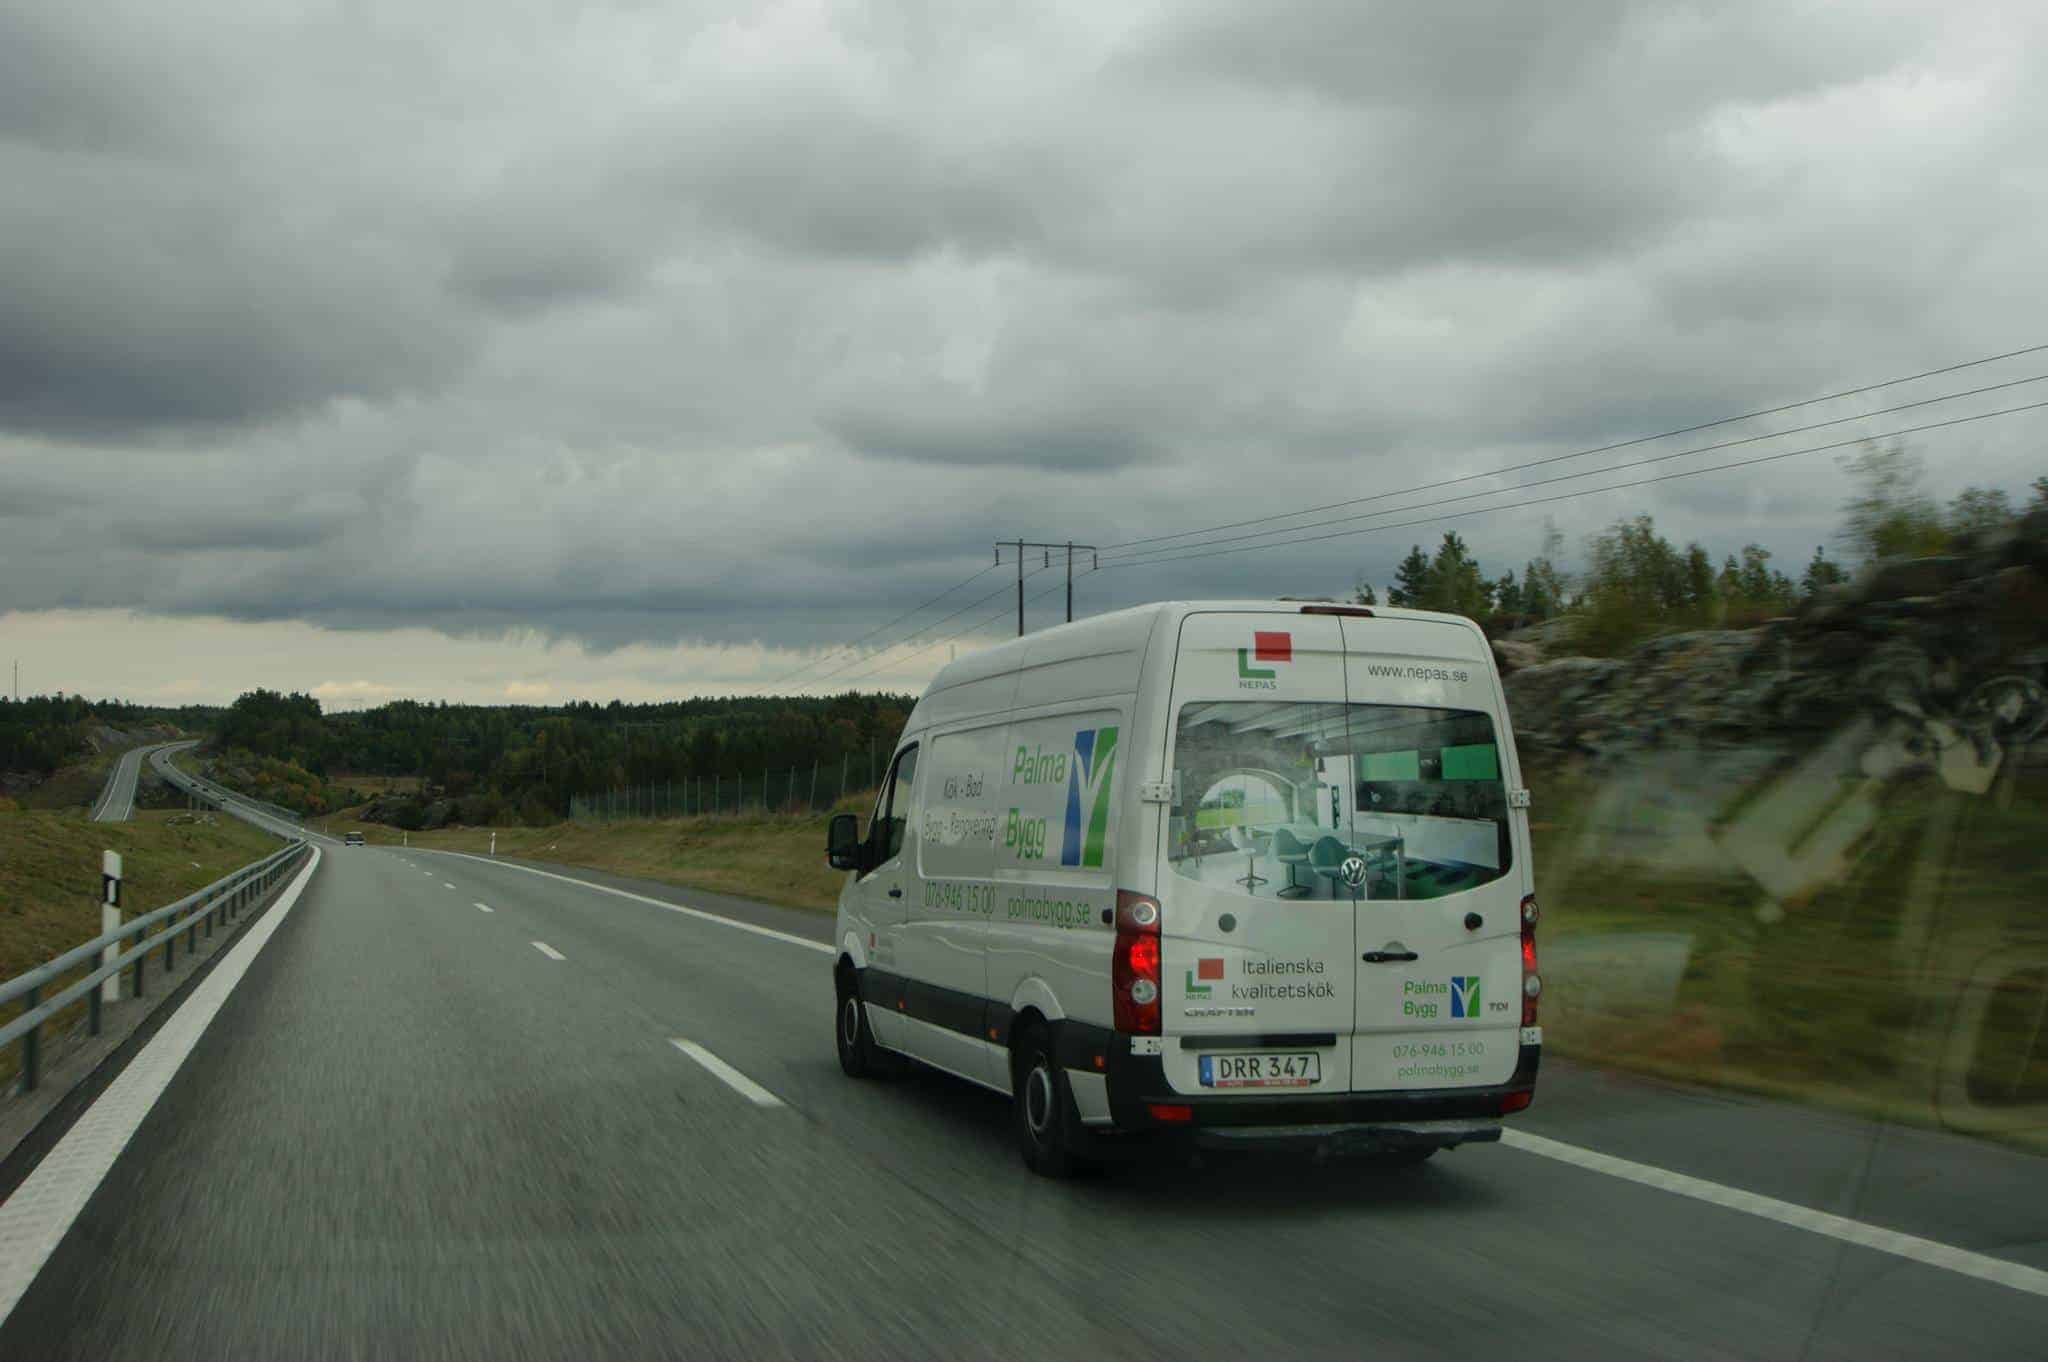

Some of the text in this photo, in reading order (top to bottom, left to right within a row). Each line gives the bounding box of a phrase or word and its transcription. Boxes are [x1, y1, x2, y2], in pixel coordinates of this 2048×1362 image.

[1367, 664, 1469, 683] www.nepas.se
[1239, 680, 1277, 690] NEPAS
[1012, 743, 1067, 785] Palma
[1006, 807, 1047, 859] Bygg
[1007, 887, 1091, 928] palmabygg.se
[1242, 958, 1325, 975] Italienska
[1231, 980, 1336, 1000] kvalitetskök
[1403, 980, 1449, 995] Palma
[1403, 1001, 1438, 1018] Bygg
[1451, 1042, 1465, 1057] 15
[1220, 1055, 1310, 1079] DRR 347
